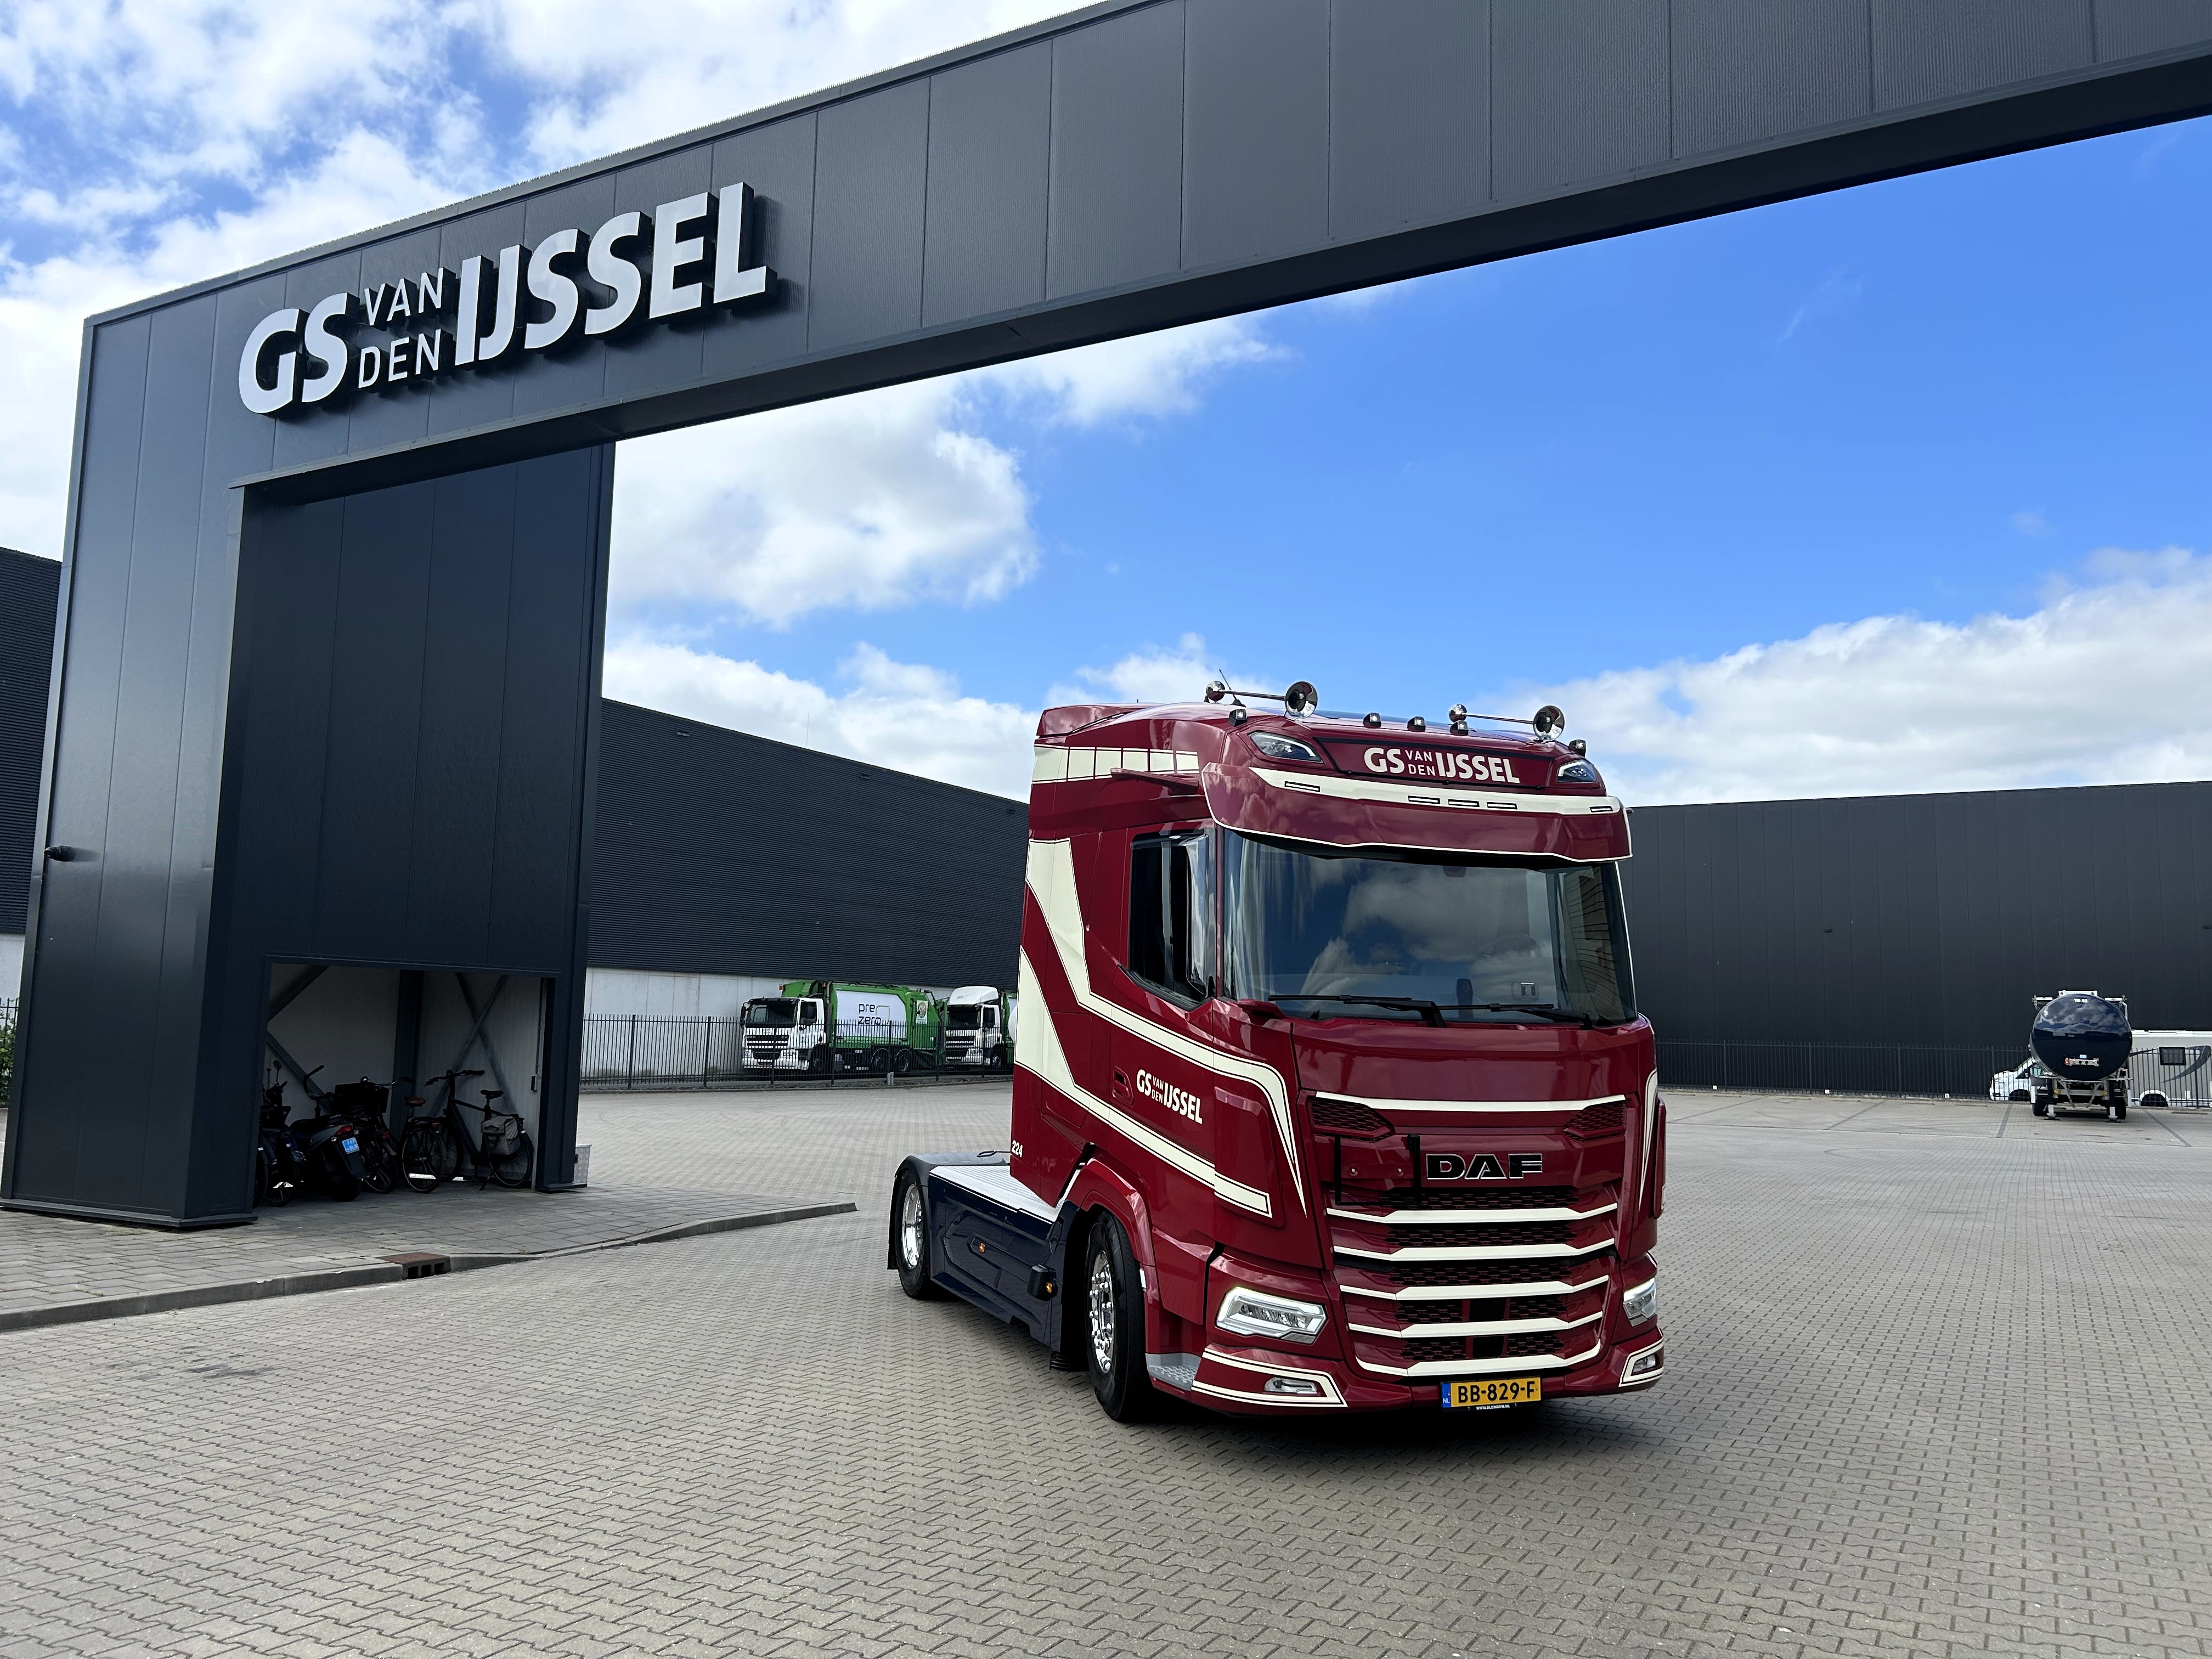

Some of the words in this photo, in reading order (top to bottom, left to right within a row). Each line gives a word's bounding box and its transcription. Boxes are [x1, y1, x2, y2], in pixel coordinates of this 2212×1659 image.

[454, 182, 767, 366] IJSSEL
[364, 267, 444, 326] VAN
[239, 292, 348, 414] GS
[358, 329, 441, 389] DEN
[1364, 747, 1405, 774] GS
[1405, 750, 1433, 762] VAN
[1435, 752, 1520, 784] IJSSEL
[1409, 764, 1436, 776] DEN
[857, 1016, 882, 1025] zero
[859, 1003, 876, 1015] pre
[1136, 1069, 1152, 1096] GS
[1153, 1075, 1164, 1091] VAN
[1151, 1089, 1163, 1104] DEN
[1163, 1082, 1203, 1125] IJSSEL
[1011, 1139, 1023, 1158] 224
[1426, 1153, 1543, 1180] DAF
[1458, 1380, 1535, 1404] BB-829-F
